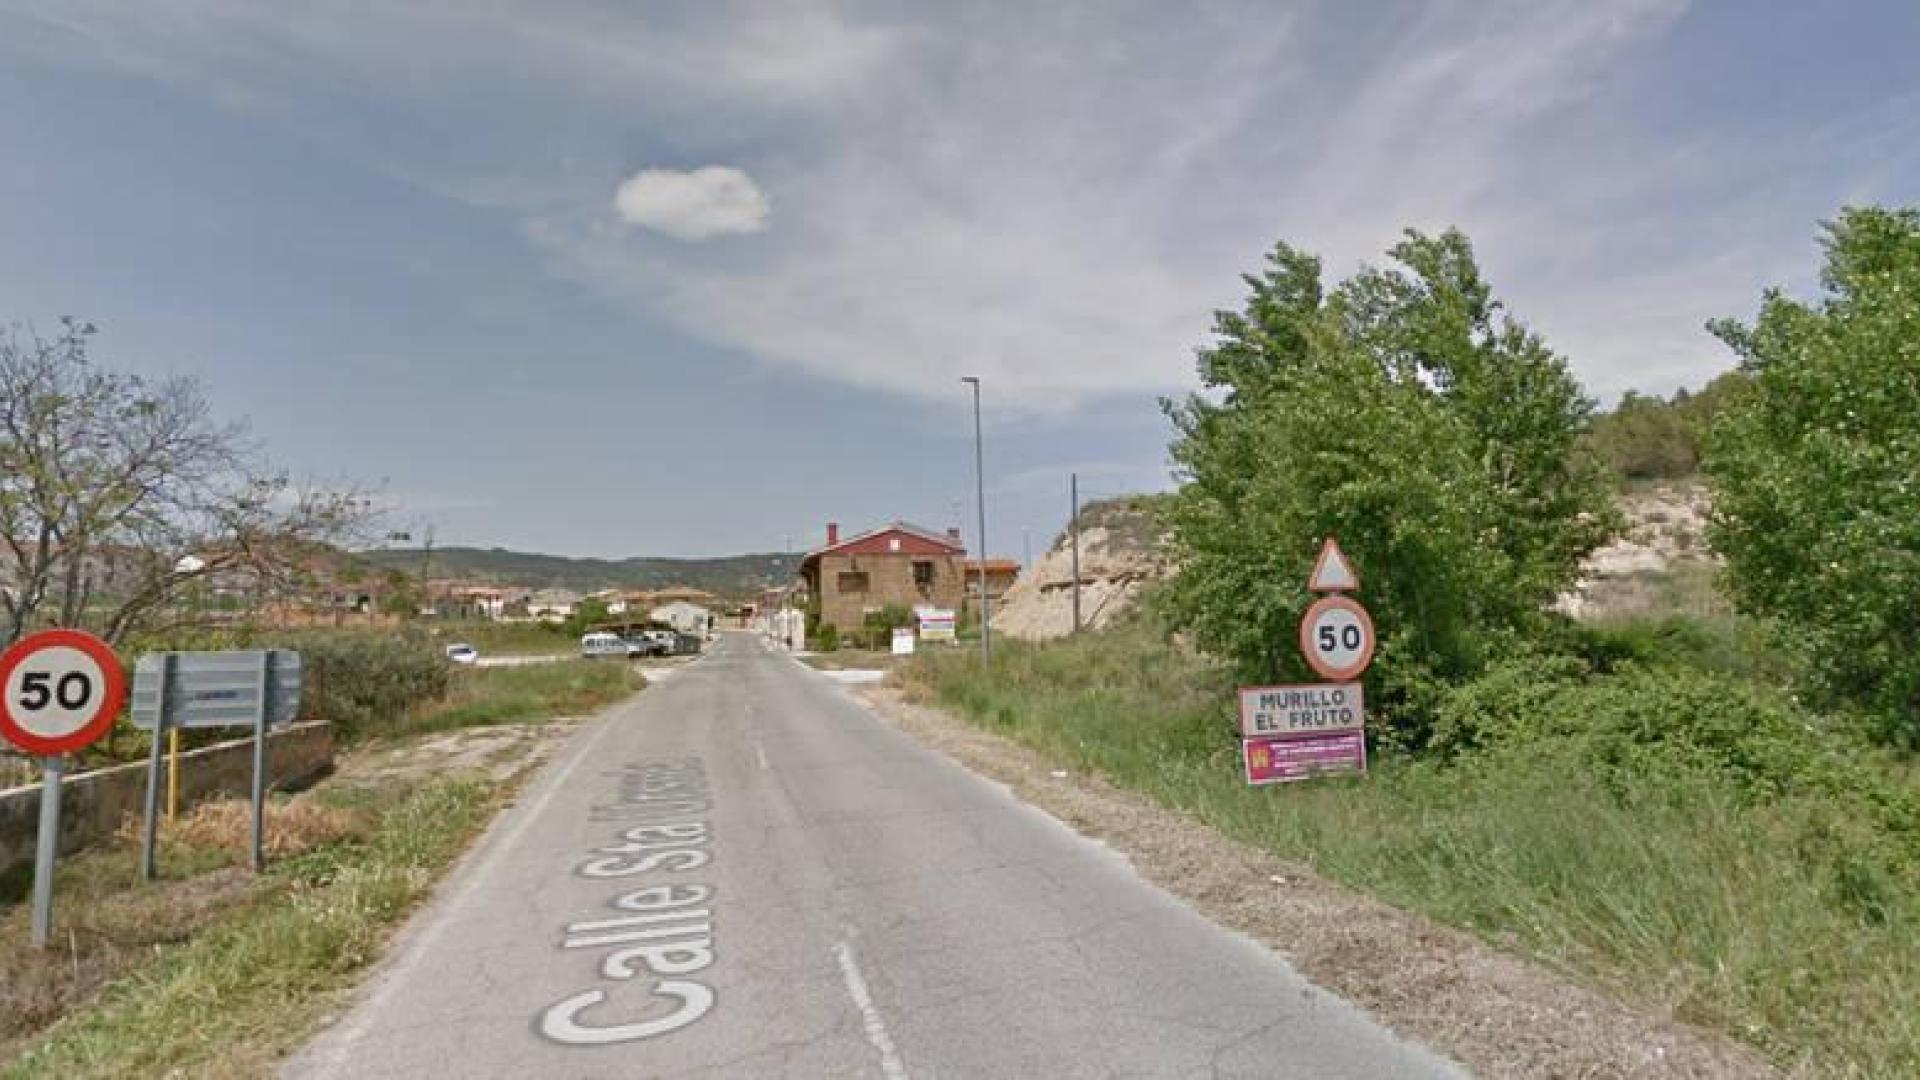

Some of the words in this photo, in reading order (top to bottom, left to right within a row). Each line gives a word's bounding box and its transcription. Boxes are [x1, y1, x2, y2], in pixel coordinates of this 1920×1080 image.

[1319, 624, 1360, 652] 50
[19, 671, 92, 711] 50
[1259, 690, 1345, 710] MURILLO
[1255, 714, 1279, 731] EL
[1289, 708, 1353, 729] FRUTO
